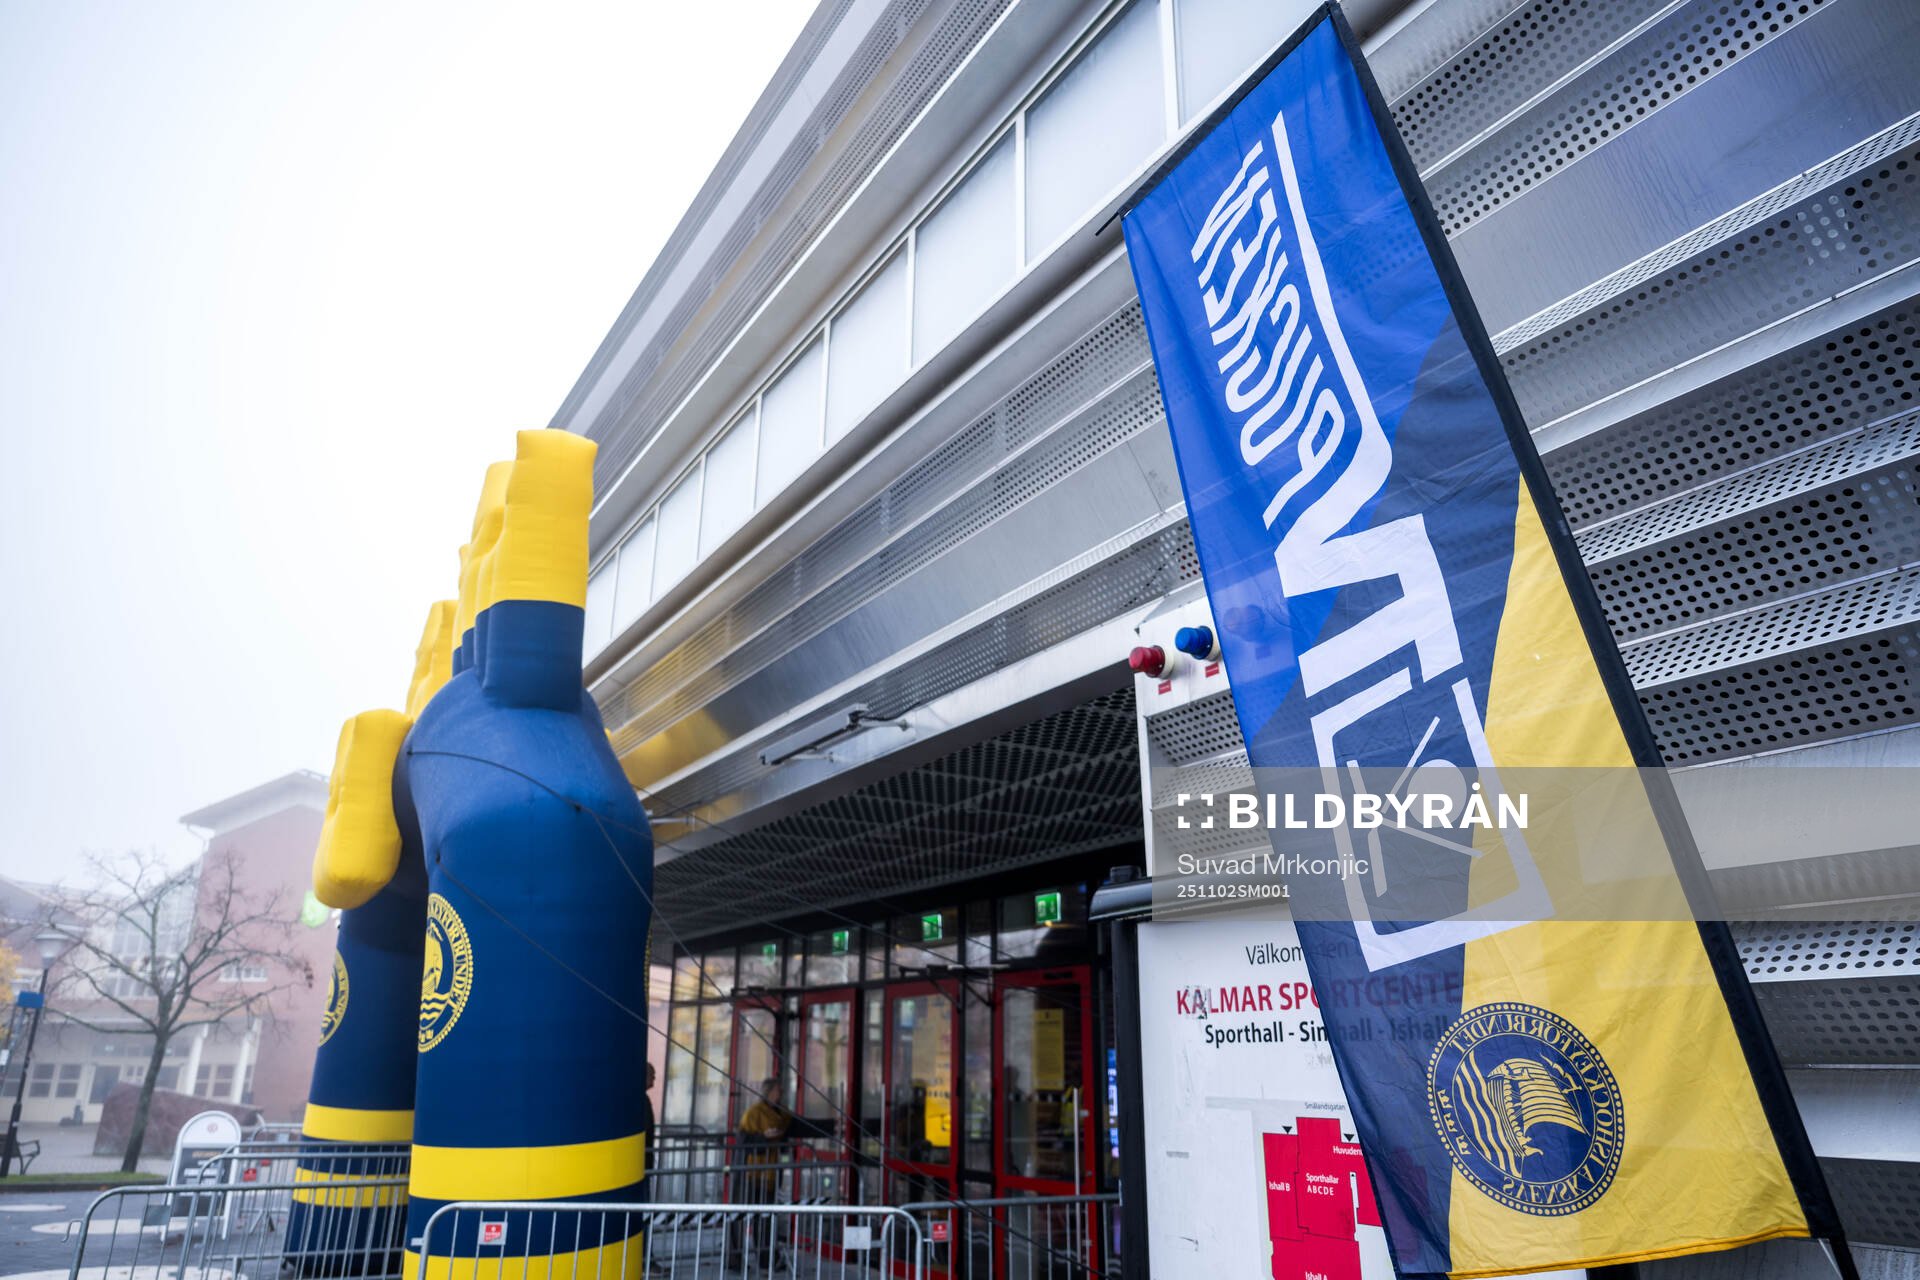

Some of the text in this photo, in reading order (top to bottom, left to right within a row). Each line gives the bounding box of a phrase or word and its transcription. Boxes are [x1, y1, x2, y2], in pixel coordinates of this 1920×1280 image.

[1176, 984, 1273, 1015] KALMAR
[1205, 1021, 1283, 1048] Sporthall
[1268, 1180, 1291, 1192] Ishall B
[1305, 1172, 1339, 1184] Sporthallar
